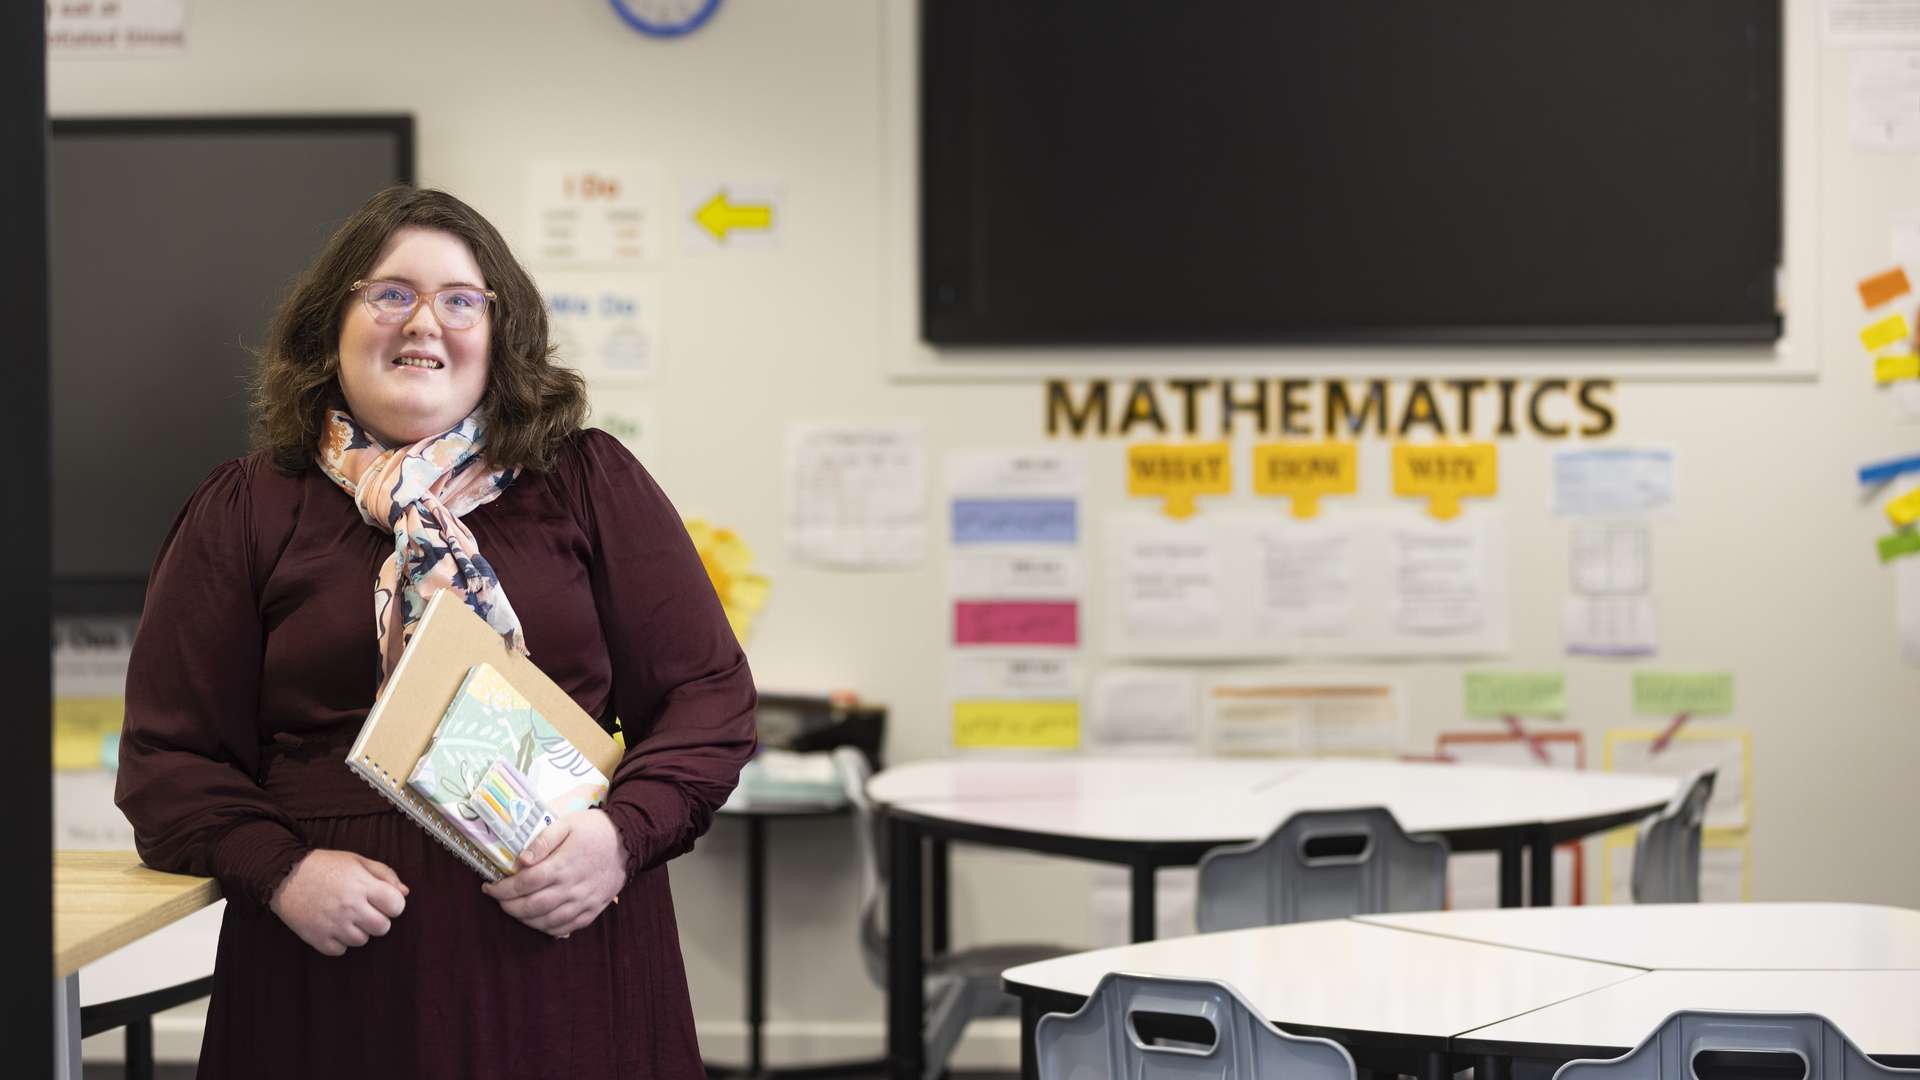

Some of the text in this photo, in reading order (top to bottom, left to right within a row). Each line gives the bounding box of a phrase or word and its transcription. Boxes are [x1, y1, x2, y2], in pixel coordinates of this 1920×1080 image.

[581, 175, 621, 200] Do
[600, 294, 639, 316] Do
[1045, 379, 1617, 437] MATHEMATICS
[1131, 456, 1224, 485] WHAT
[1266, 456, 1344, 483] HOW
[1408, 456, 1478, 484] WHY
